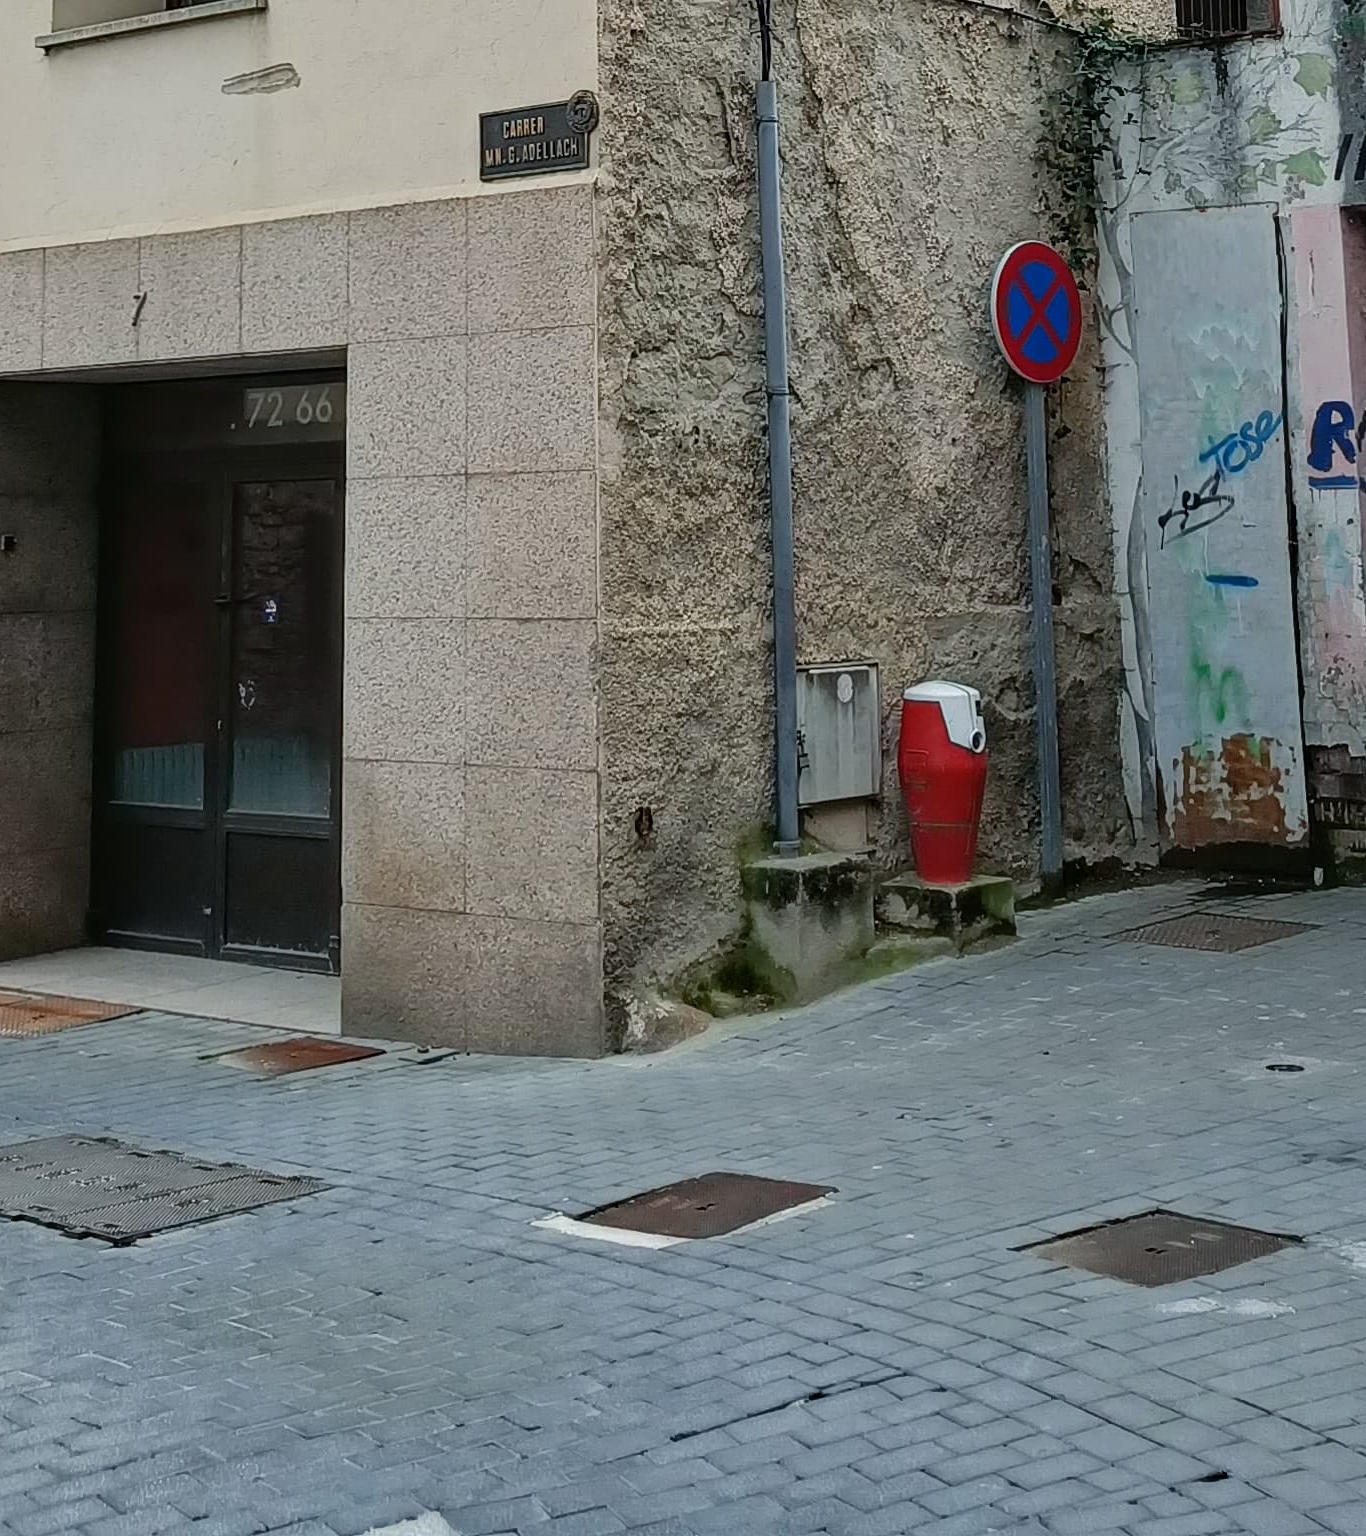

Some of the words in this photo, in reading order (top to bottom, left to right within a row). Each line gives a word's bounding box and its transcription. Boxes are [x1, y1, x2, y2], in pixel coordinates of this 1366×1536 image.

[503, 116, 544, 139] CARRER
[522, 137, 578, 163] ADELLACH
[131, 291, 147, 327] 7
[246, 390, 283, 429] 72
[295, 385, 332, 425] 66
